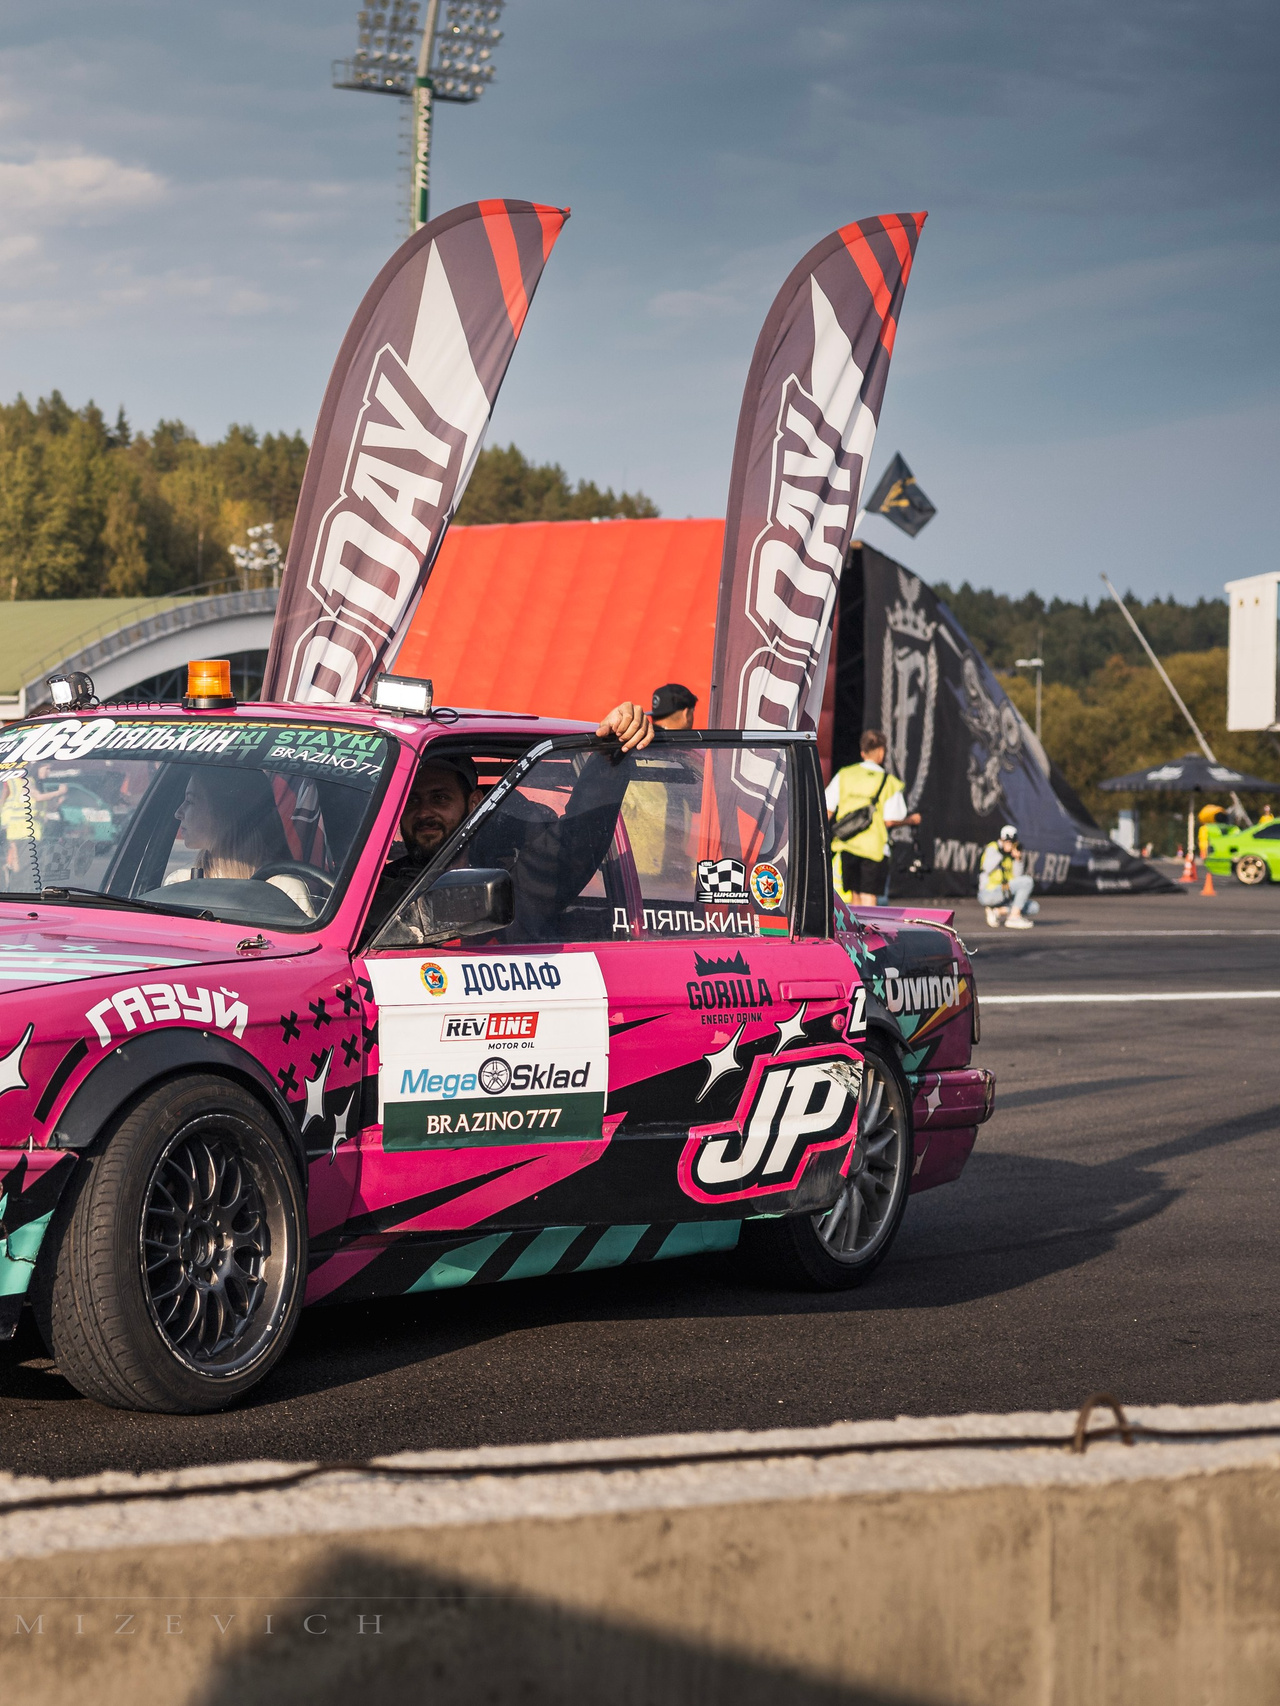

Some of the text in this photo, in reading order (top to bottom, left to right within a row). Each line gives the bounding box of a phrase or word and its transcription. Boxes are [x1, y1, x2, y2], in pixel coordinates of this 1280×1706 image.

[327, 370, 453, 613] DAY
[758, 405, 855, 643] DAY
[2, 718, 115, 763] 169
[106, 727, 242, 753] ЛЯЛЬКИН
[275, 730, 383, 751] STAYKI
[613, 907, 755, 934] Д. ЛЯЛЬКИН
[461, 962, 562, 996] ДОСААФ
[687, 978, 772, 1011] GORILLA
[884, 961, 960, 1013] Divinol
[85, 983, 249, 1048] ГАЗУЙ
[701, 1012, 763, 1025] ENERGY DRINK
[488, 1041, 535, 1050] MOTOR OIL
[400, 1062, 591, 1099] Mega Sklad
[697, 1061, 863, 1184] JP
